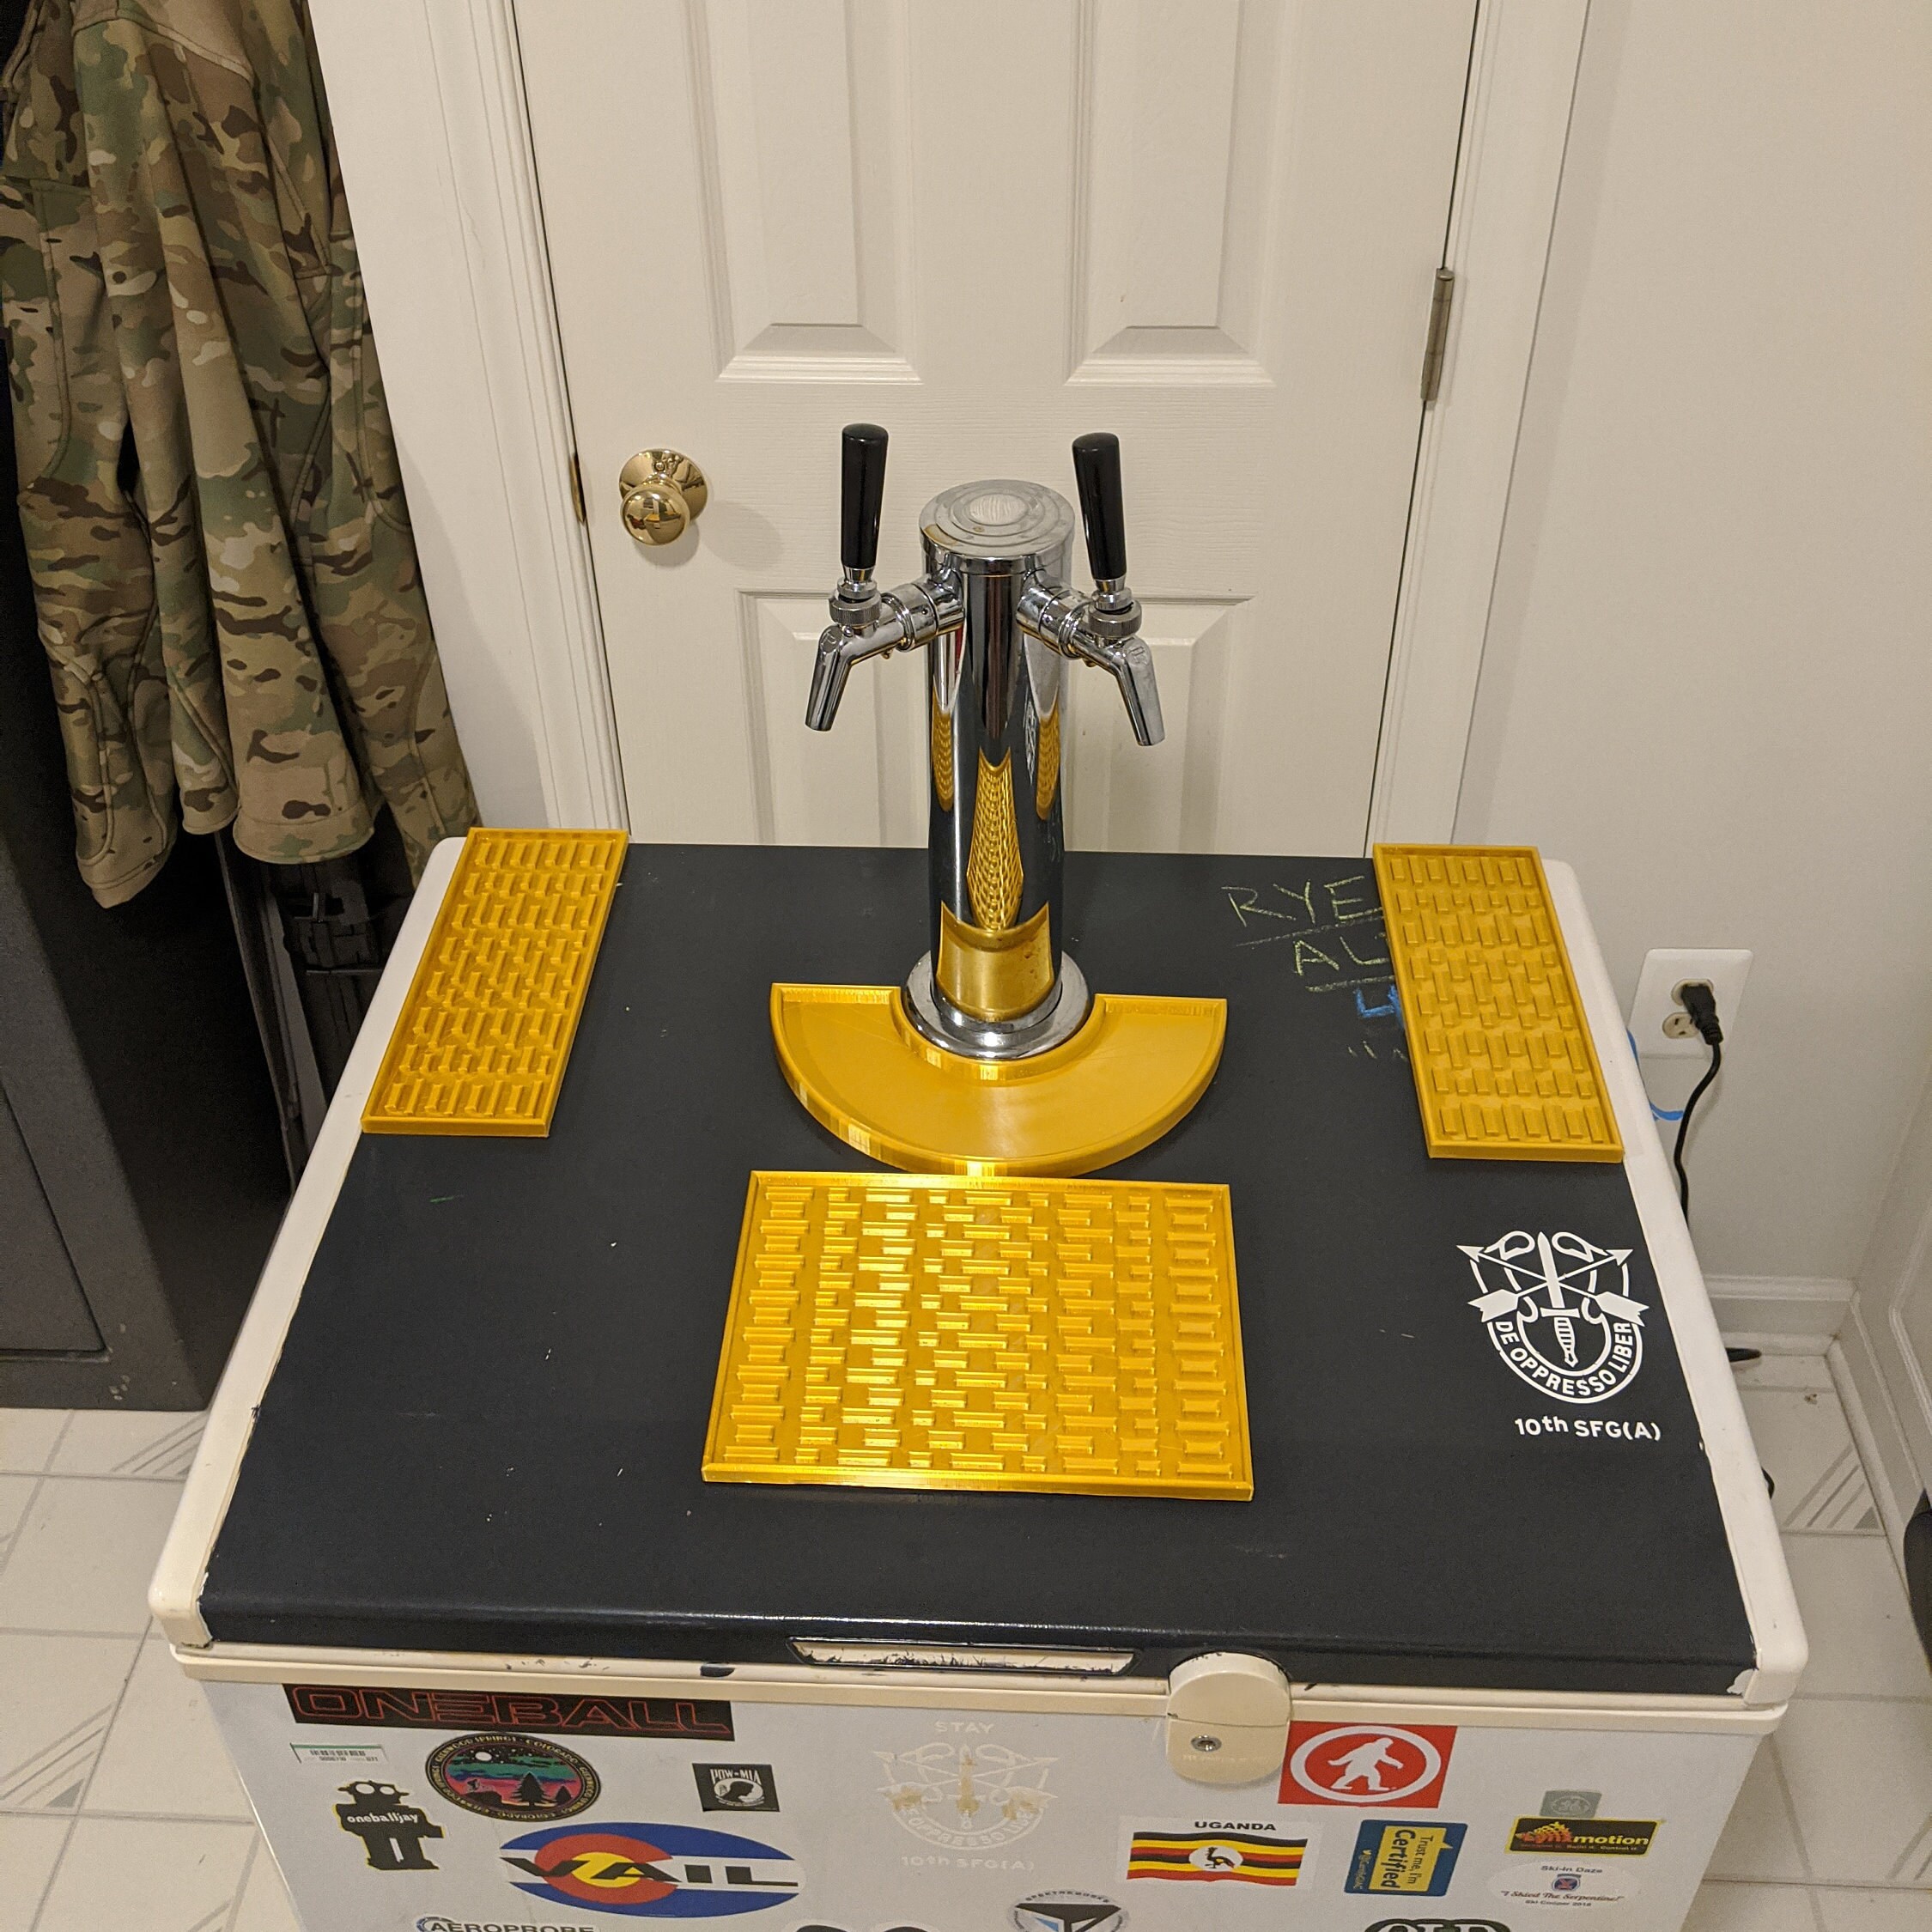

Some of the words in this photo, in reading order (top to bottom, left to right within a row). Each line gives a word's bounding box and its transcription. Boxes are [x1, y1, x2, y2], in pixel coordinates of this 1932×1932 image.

[1221, 875, 1383, 927] RYE
[1291, 936, 1392, 976] AL
[1495, 1320, 1520, 1345] DE
[1510, 1346, 1617, 1396] OPPRESSO
[1607, 1321, 1633, 1373] LIBER
[1514, 1415, 1569, 1436] 10th
[1575, 1419, 1662, 1441] SFG(A)
[293, 1686, 730, 1735] ONEBALL
[933, 1721, 994, 1734] STAY
[346, 1812, 419, 1824] oneballjay
[1194, 1821, 1277, 1832] UGANDA
[1415, 1835, 1434, 1856] Trust
[500, 1857, 799, 1887] VAIL
[1381, 1829, 1416, 1889] Certified
[1409, 1858, 1424, 1871] me,
[1406, 1873, 1422, 1885] I'm
